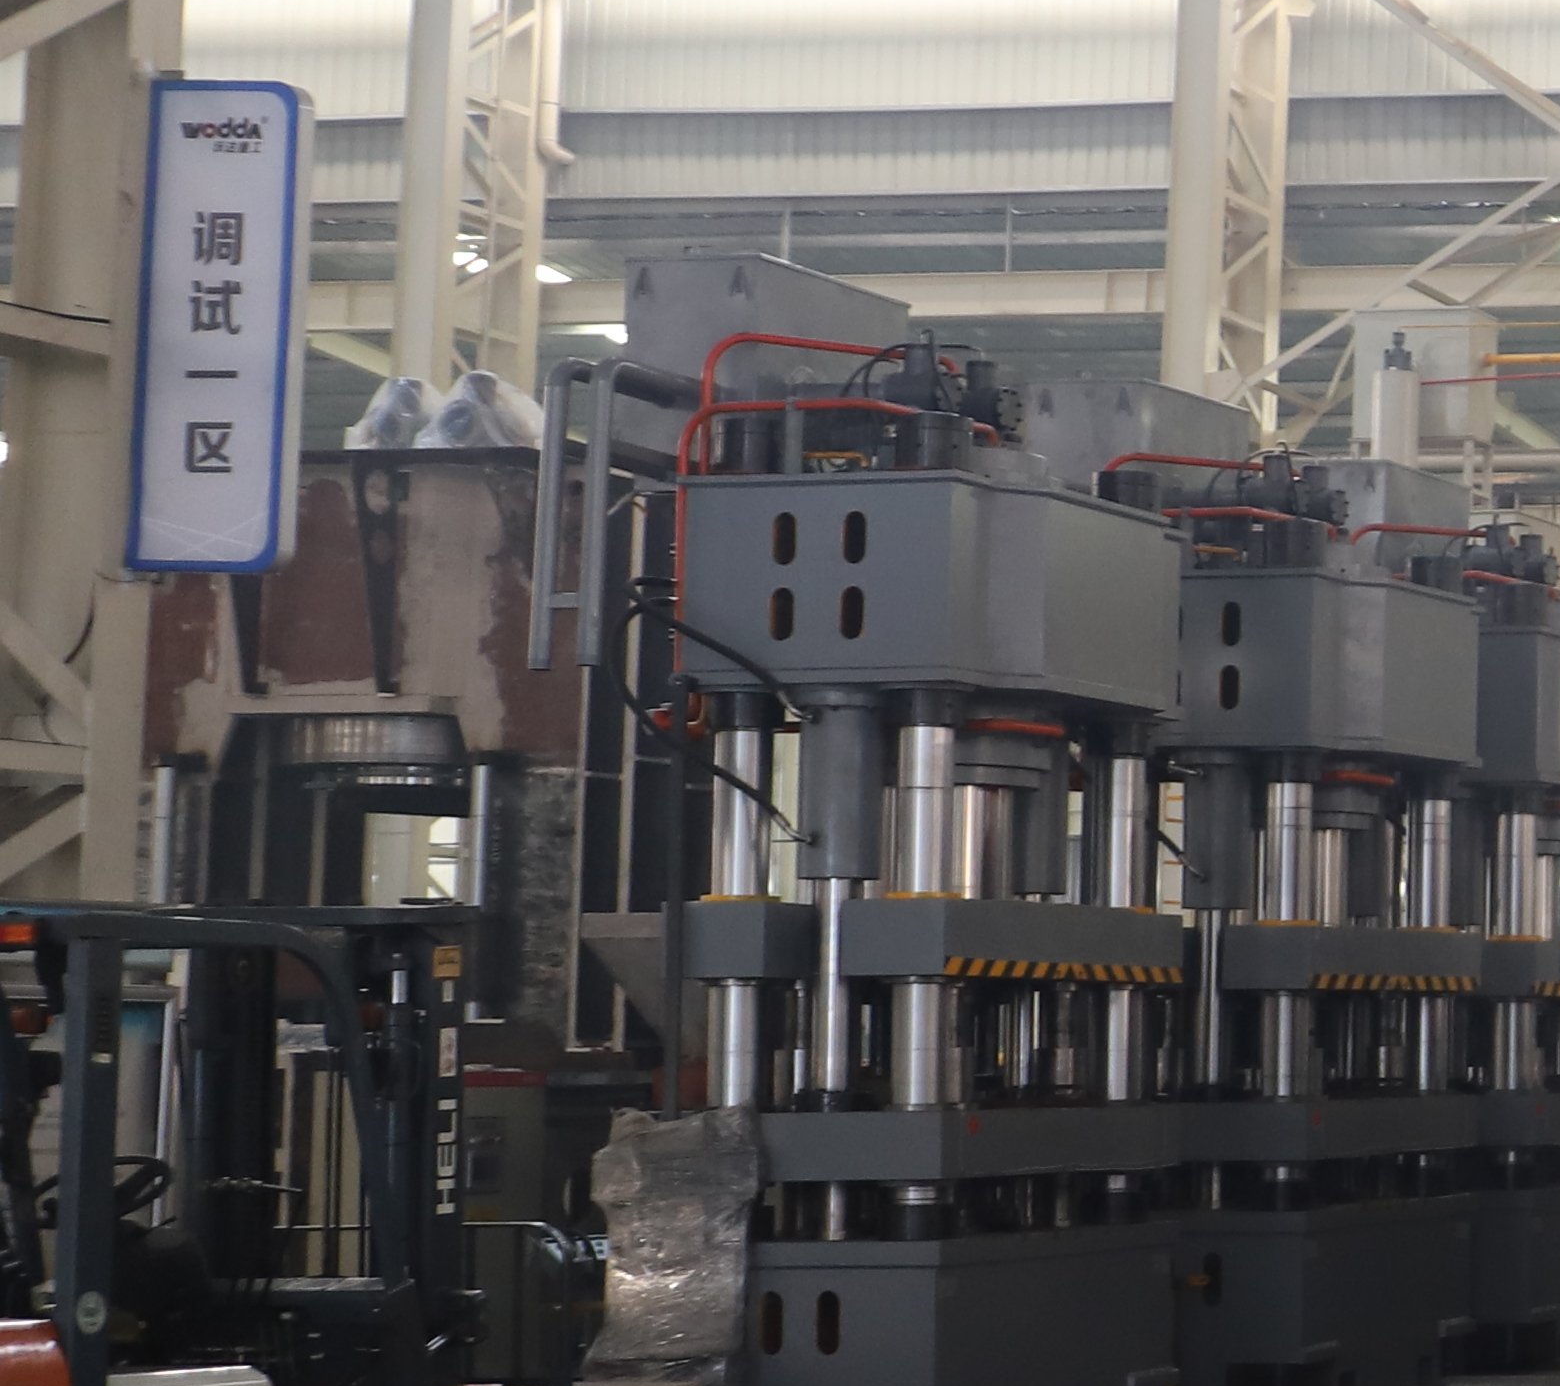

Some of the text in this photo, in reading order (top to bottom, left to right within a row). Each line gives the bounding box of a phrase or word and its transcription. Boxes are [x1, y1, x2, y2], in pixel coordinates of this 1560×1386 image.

[183, 210, 245, 475] 调试一区
[437, 1096, 458, 1216] HELI
